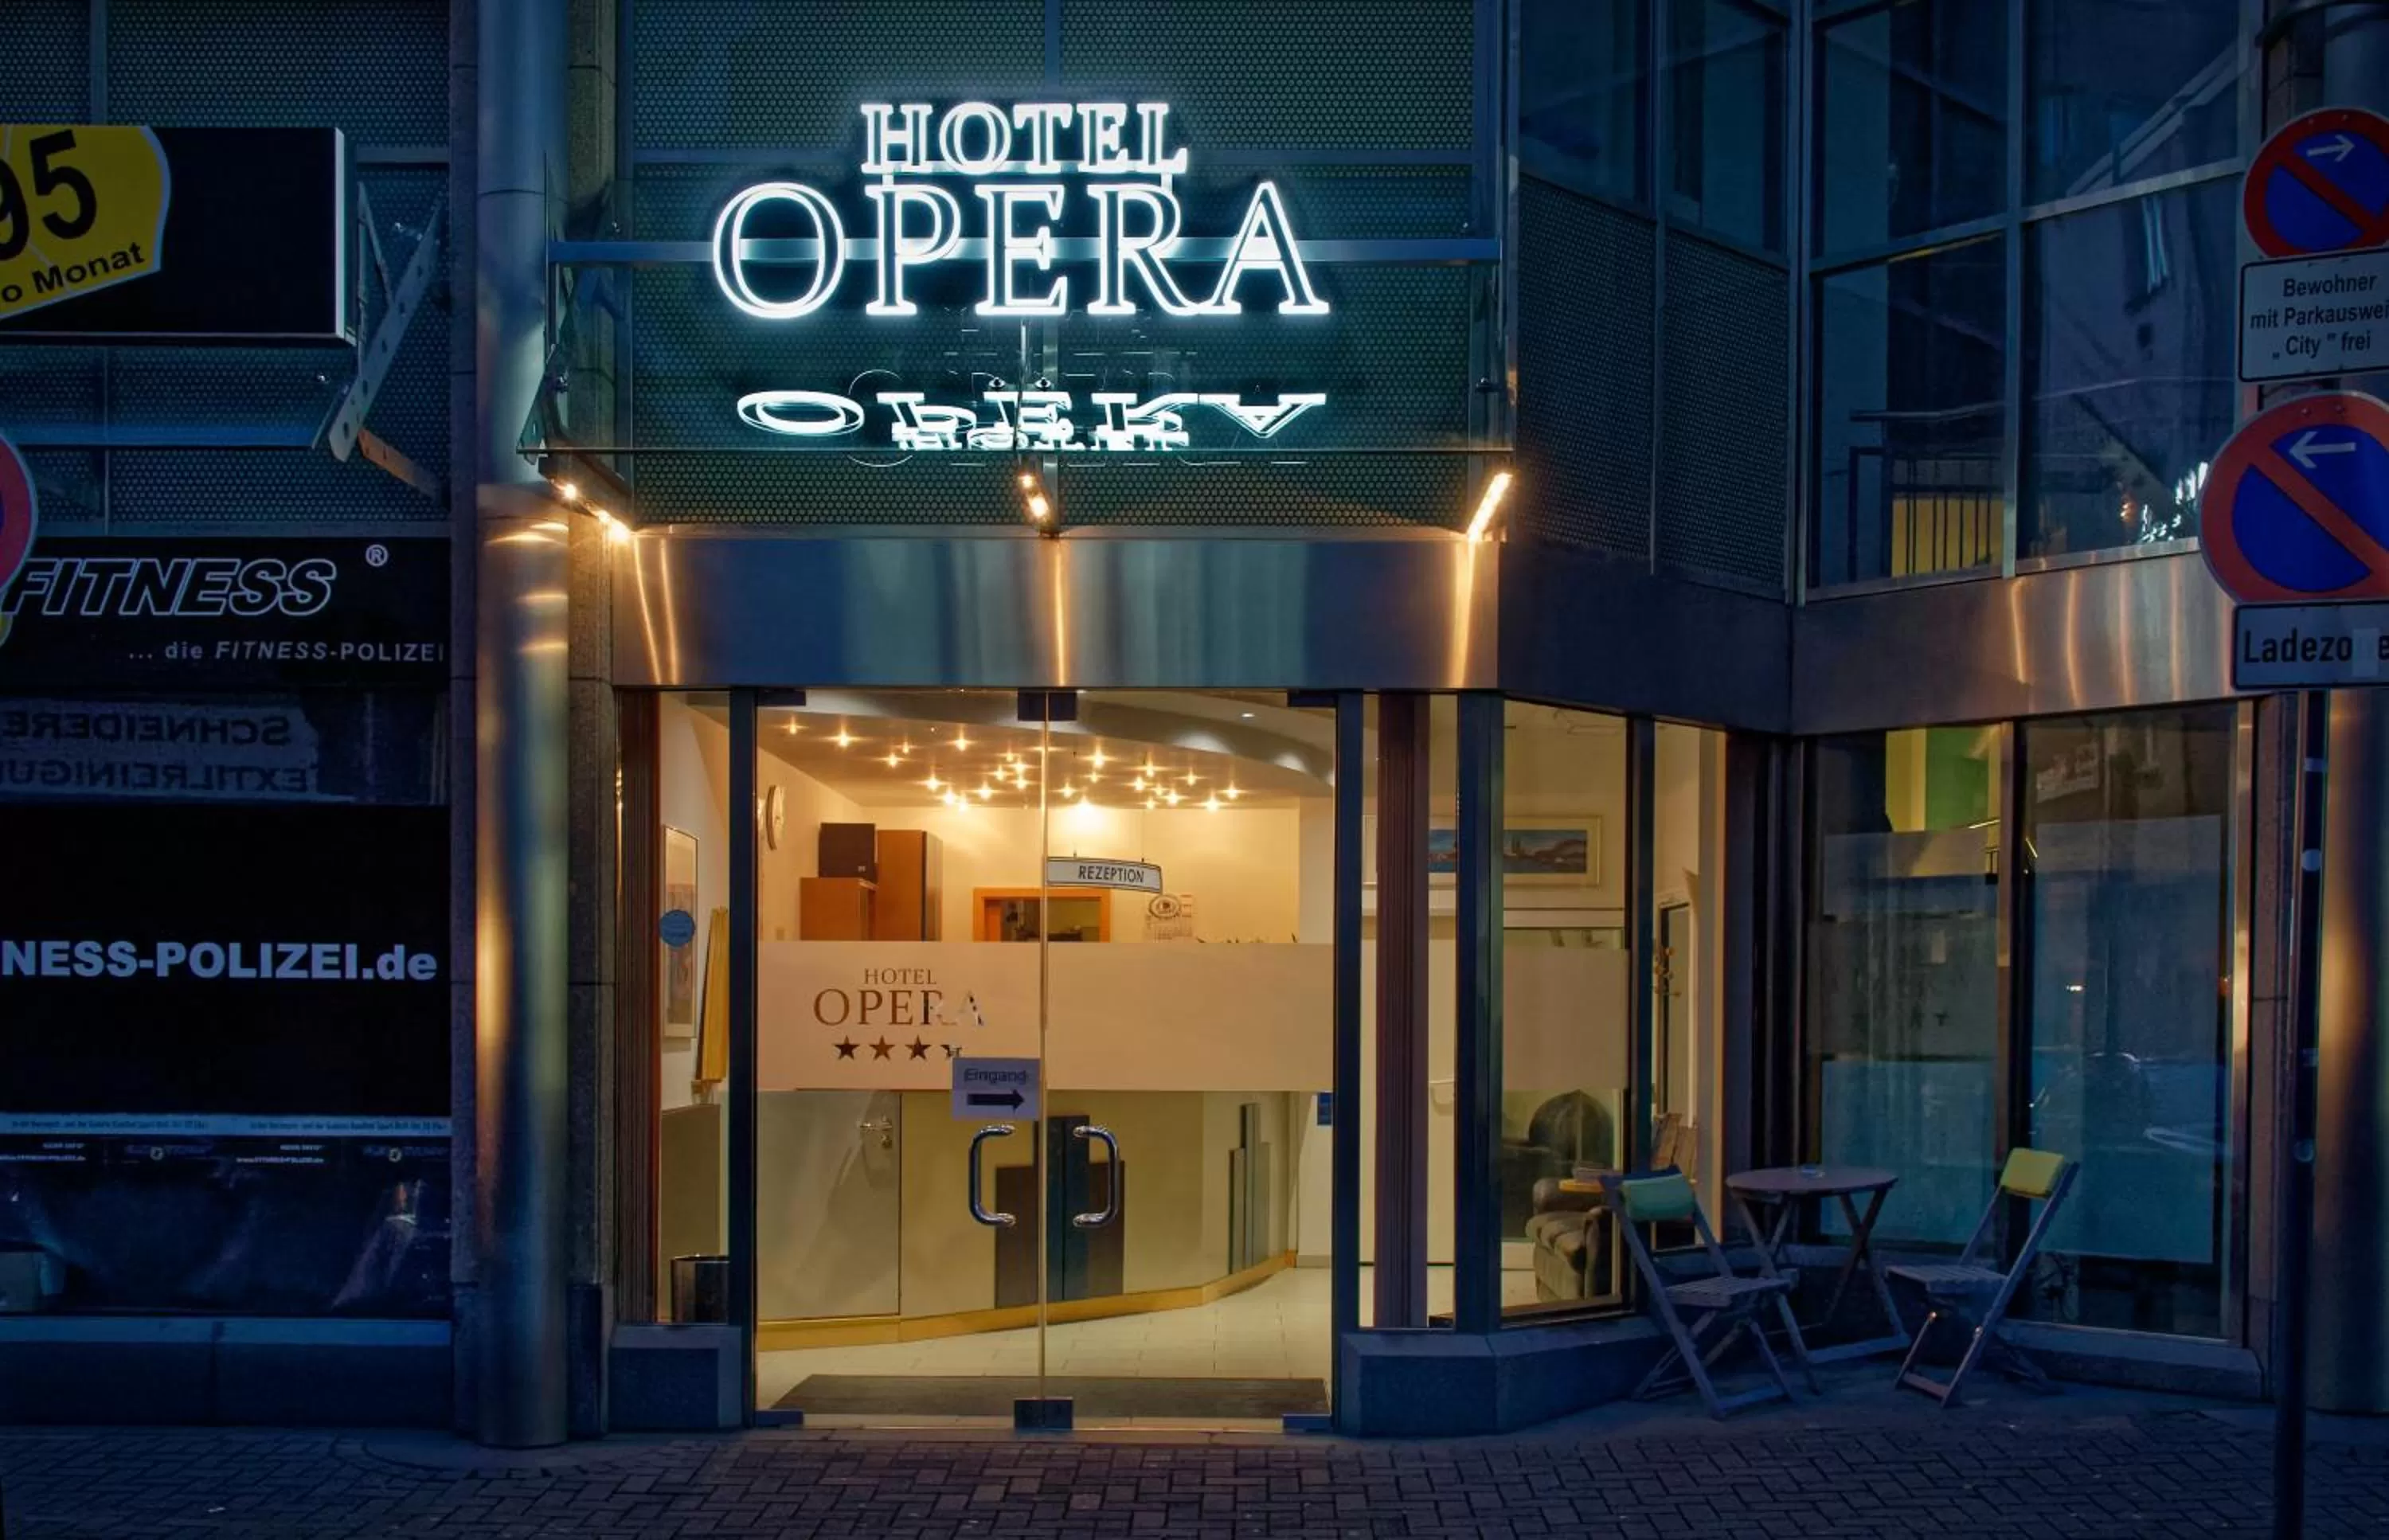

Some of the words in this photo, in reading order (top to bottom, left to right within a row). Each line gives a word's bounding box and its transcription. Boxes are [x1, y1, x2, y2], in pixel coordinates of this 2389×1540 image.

[861, 102, 1188, 174] HOTEL
[713, 181, 1331, 319] OPERA
[32, 242, 145, 294] Monat
[2283, 274, 2377, 297] Bewohner
[2250, 308, 2278, 329] mit
[2341, 330, 2371, 351] frei
[2, 557, 338, 616] FITNESS
[165, 642, 205, 660] die
[214, 640, 445, 663] FITNESS-POLIZEI
[2243, 627, 2389, 664] Ladezoe
[1078, 865, 1144, 883] REZEPTION
[2, 940, 438, 980] NESS-POLIZEI.de
[864, 968, 936, 985] HOTEL
[813, 988, 984, 1026] OPERA
[964, 1068, 1026, 1085] Eingang
